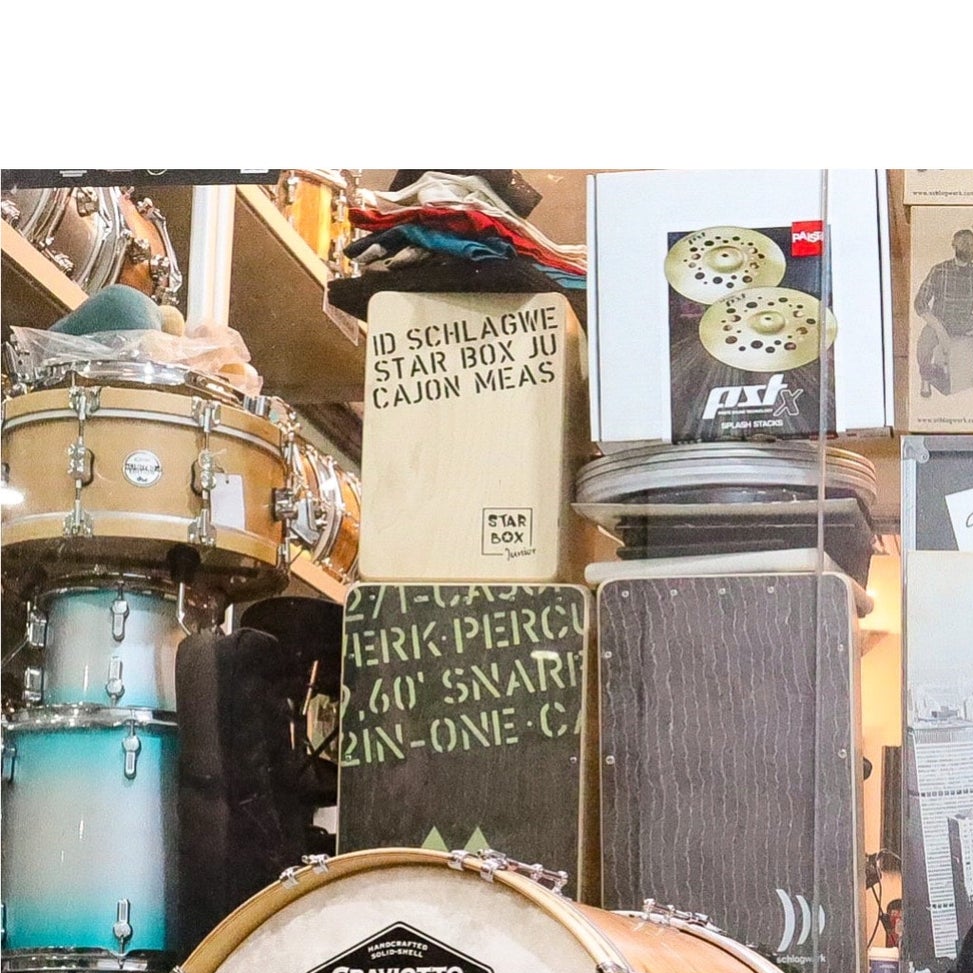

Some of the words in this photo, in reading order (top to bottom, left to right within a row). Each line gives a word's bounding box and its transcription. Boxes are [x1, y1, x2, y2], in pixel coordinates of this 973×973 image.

[373, 332, 396, 356] ID
[406, 306, 558, 351] SCHLAGWE
[374, 351, 447, 382] STAR
[460, 339, 515, 369] BOX
[528, 333, 557, 359] JU
[373, 375, 460, 409] CAJON
[474, 361, 555, 394] MEAS
[488, 513, 527, 528] STAR
[491, 531, 525, 544] BOX
[368, 940, 428, 952] HANDCRAFTED
[370, 949, 423, 960] SOLID-SHELL
